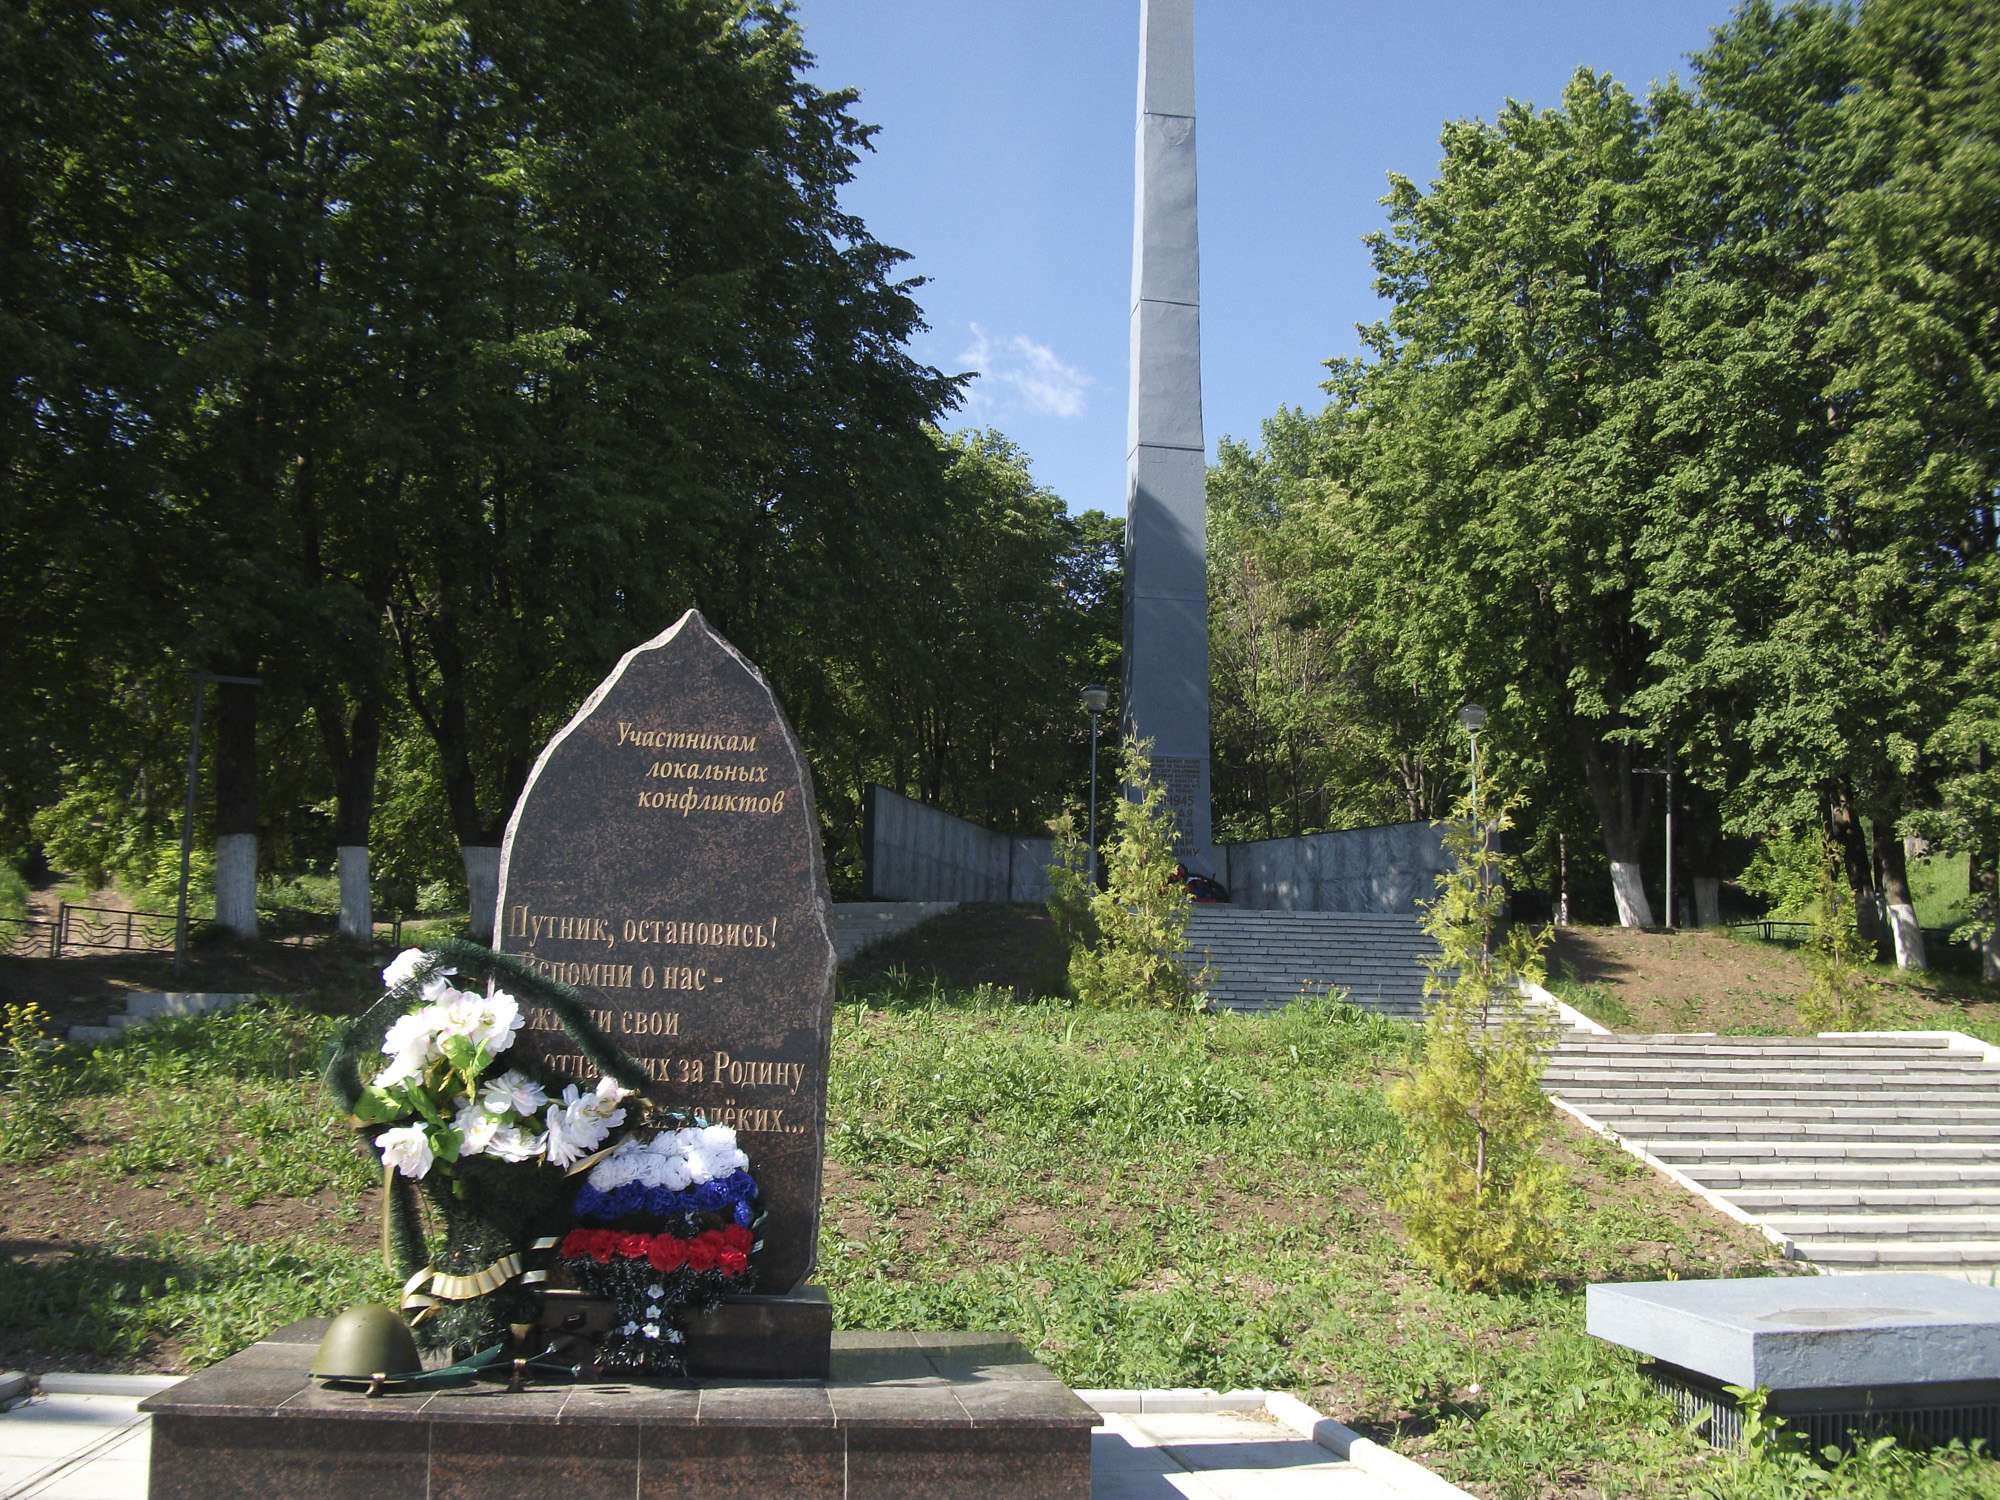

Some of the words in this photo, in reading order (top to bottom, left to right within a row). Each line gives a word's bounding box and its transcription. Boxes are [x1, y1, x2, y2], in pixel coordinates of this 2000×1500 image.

[617, 722, 757, 752] Участникам
[646, 760, 769, 783] локальных
[638, 787, 786, 818] конфликтов
[507, 905, 616, 948] Путник,
[623, 916, 778, 949] остановись!
[641, 965, 656, 989] о
[662, 966, 707, 991] нас
[529, 1007, 612, 1033] жии
[621, 1010, 680, 1036] свои
[678, 1058, 705, 1083] за
[712, 1051, 805, 1095] Родину
